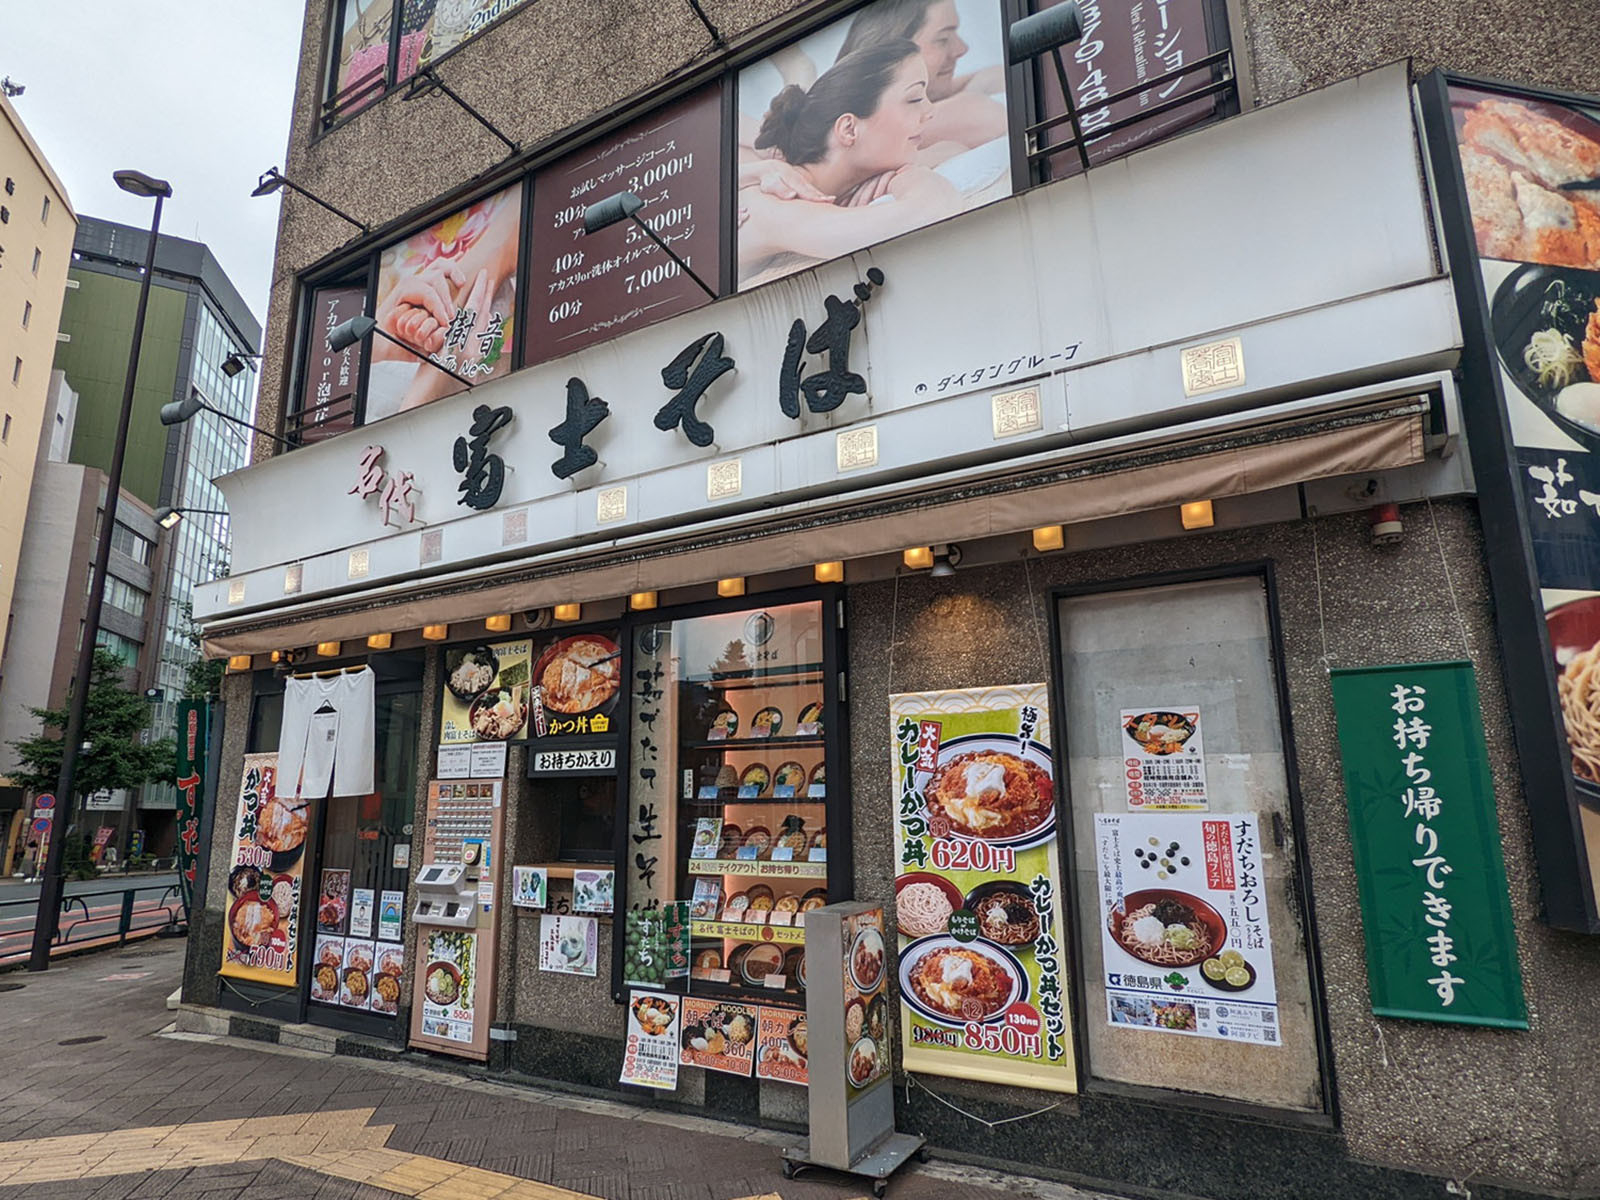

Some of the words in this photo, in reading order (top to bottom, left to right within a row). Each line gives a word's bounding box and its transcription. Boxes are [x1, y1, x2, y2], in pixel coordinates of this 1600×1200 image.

[628, 153, 693, 193] 3,000円
[625, 203, 692, 244] 5,000円
[552, 251, 585, 275] 40分
[549, 299, 583, 323] 60分
[937, 341, 1083, 393] ダイタングループ
[453, 267, 886, 511] 富士そば
[548, 715, 588, 735] かつ丼
[539, 751, 612, 770] お持ちかえり
[919, 724, 938, 770] 大人気
[238, 767, 260, 842] かつ丼
[897, 718, 927, 867] カレーかつ丼
[932, 840, 1015, 870] 620円
[1391, 683, 1466, 1007] お持ち帰りできます
[1235, 820, 1260, 922] すだちおろし
[1031, 875, 1065, 1059] カレーかつ丼セット
[1123, 974, 1164, 990] 徳島県
[685, 1000, 720, 1012] MORNING
[721, 1004, 756, 1017] NOODLES
[686, 1009, 726, 1029] 朝そば
[761, 1009, 797, 1020] MORNING
[724, 1041, 752, 1059] 360円
[964, 1022, 1042, 1057] 850円
